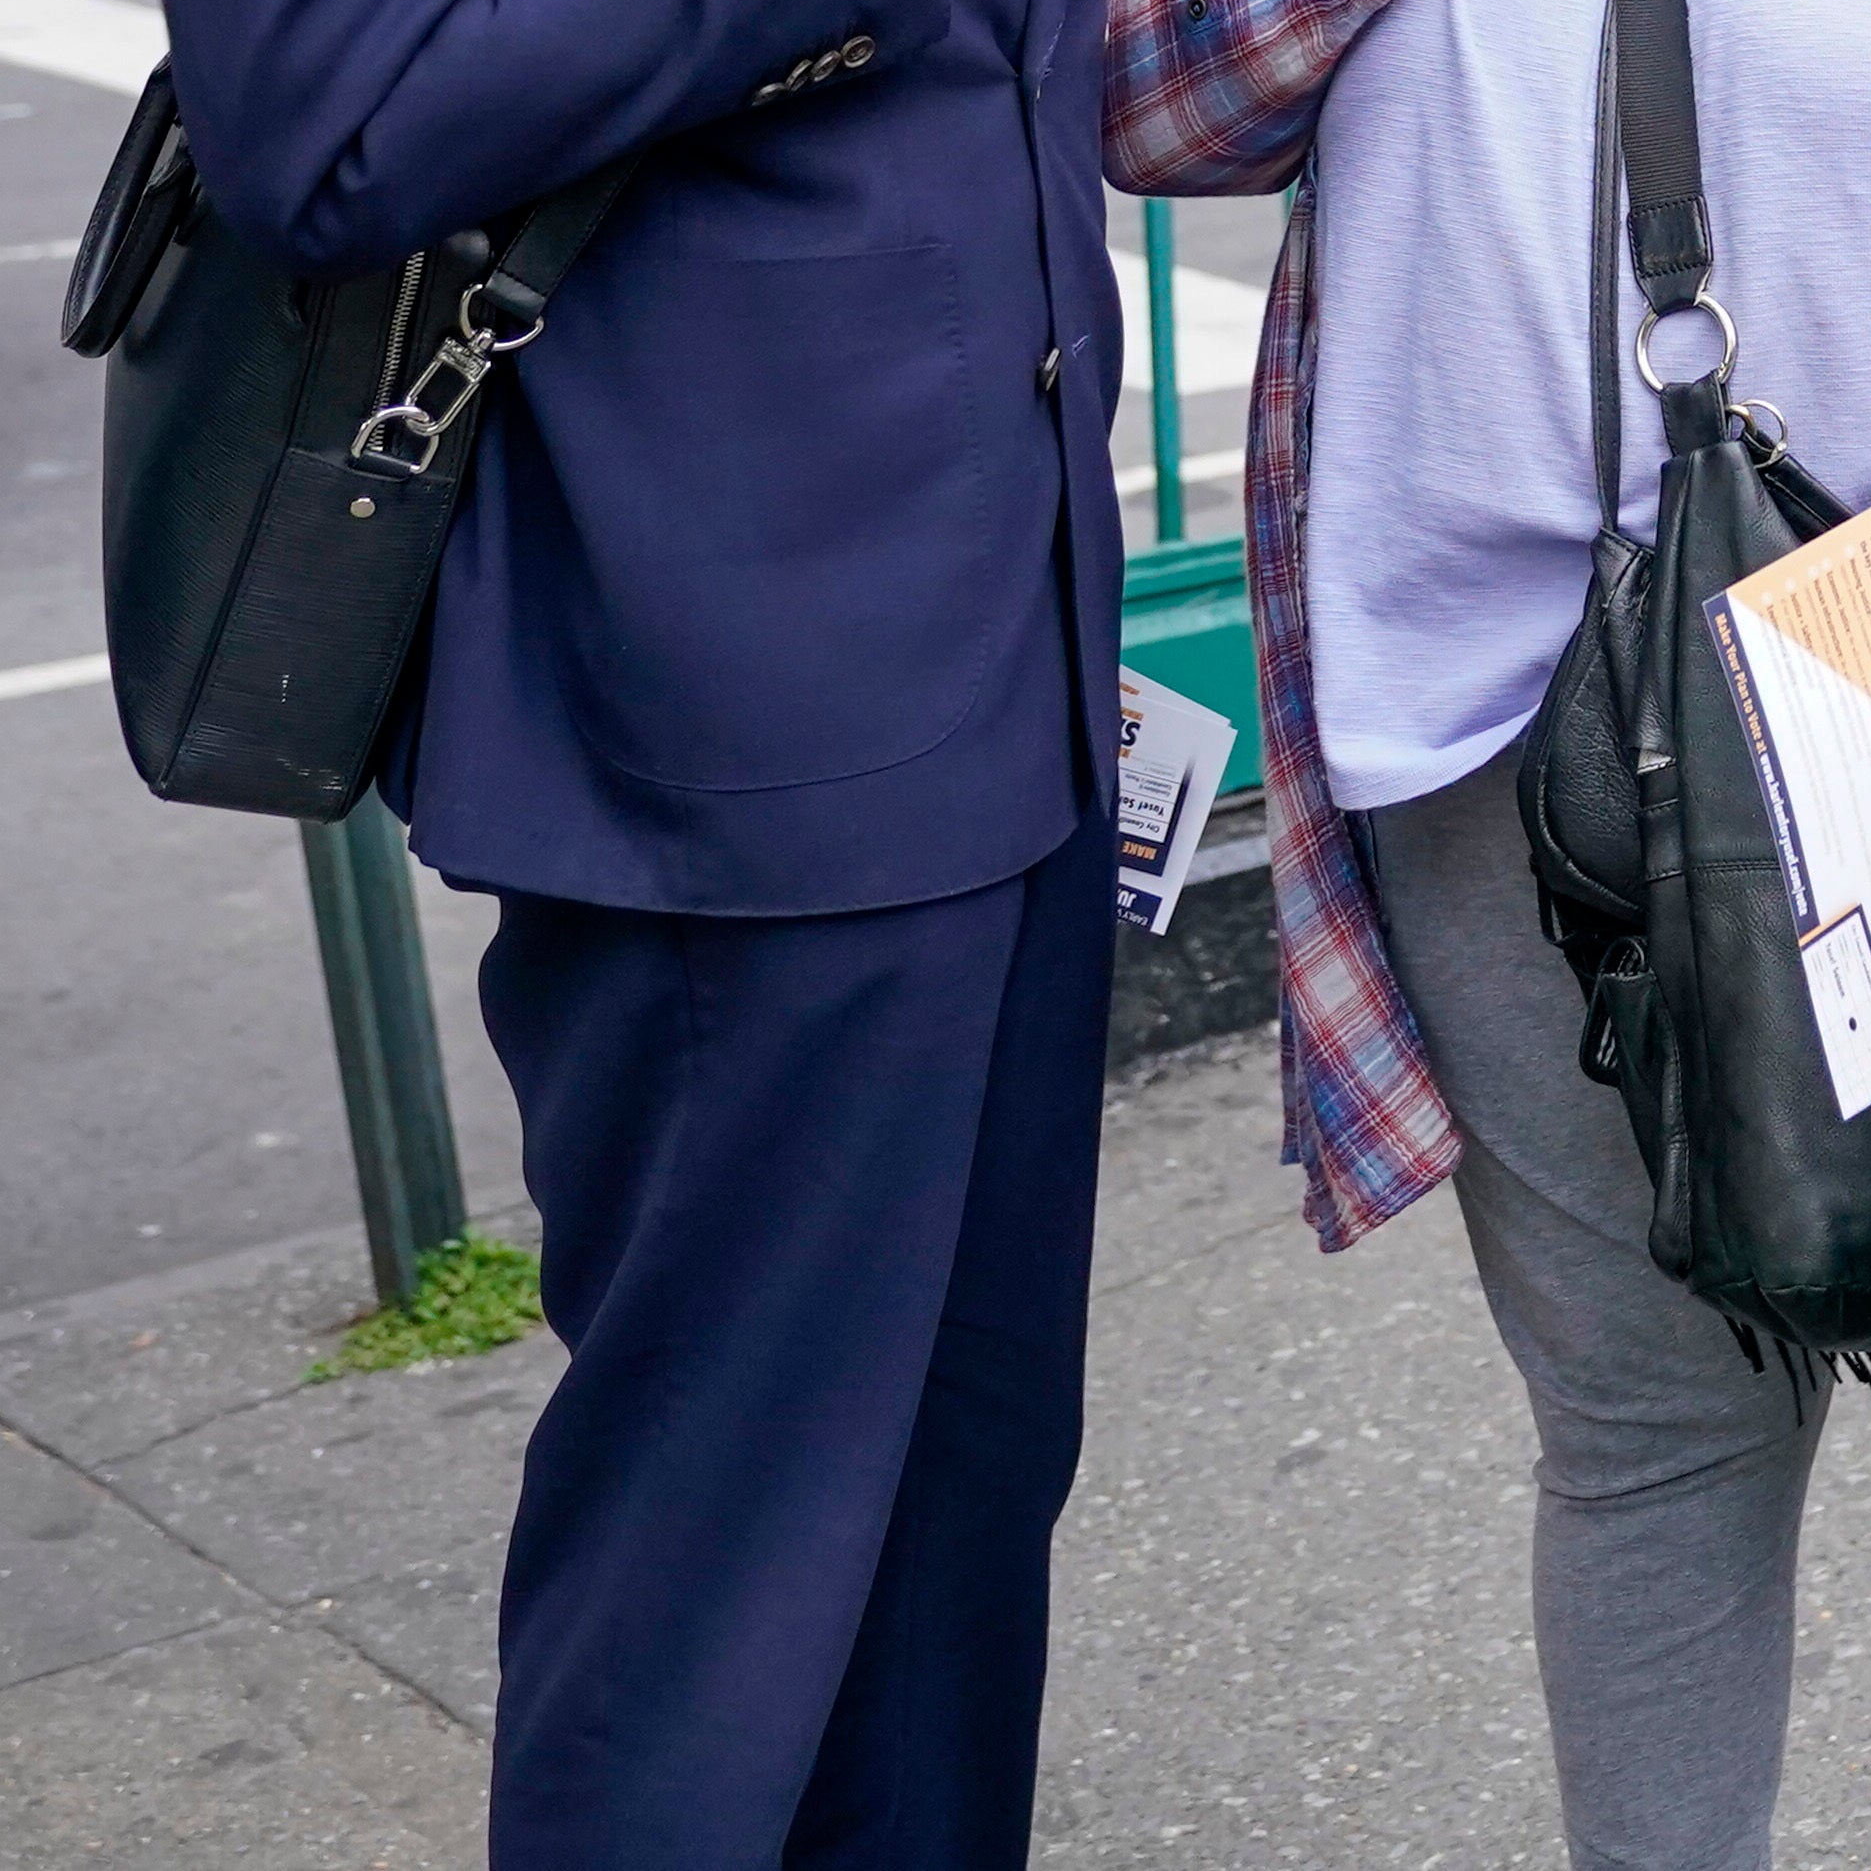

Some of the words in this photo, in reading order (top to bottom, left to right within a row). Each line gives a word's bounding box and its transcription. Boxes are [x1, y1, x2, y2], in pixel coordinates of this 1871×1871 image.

[1714, 612, 1731, 647] Make
[1725, 643, 1740, 673] Your
[1734, 671, 1749, 700] Plan
[1743, 696, 1754, 714] to
[1747, 711, 1763, 741] Vote
[1755, 739, 1767, 755] at
[1122, 841, 1158, 861] MAKE
